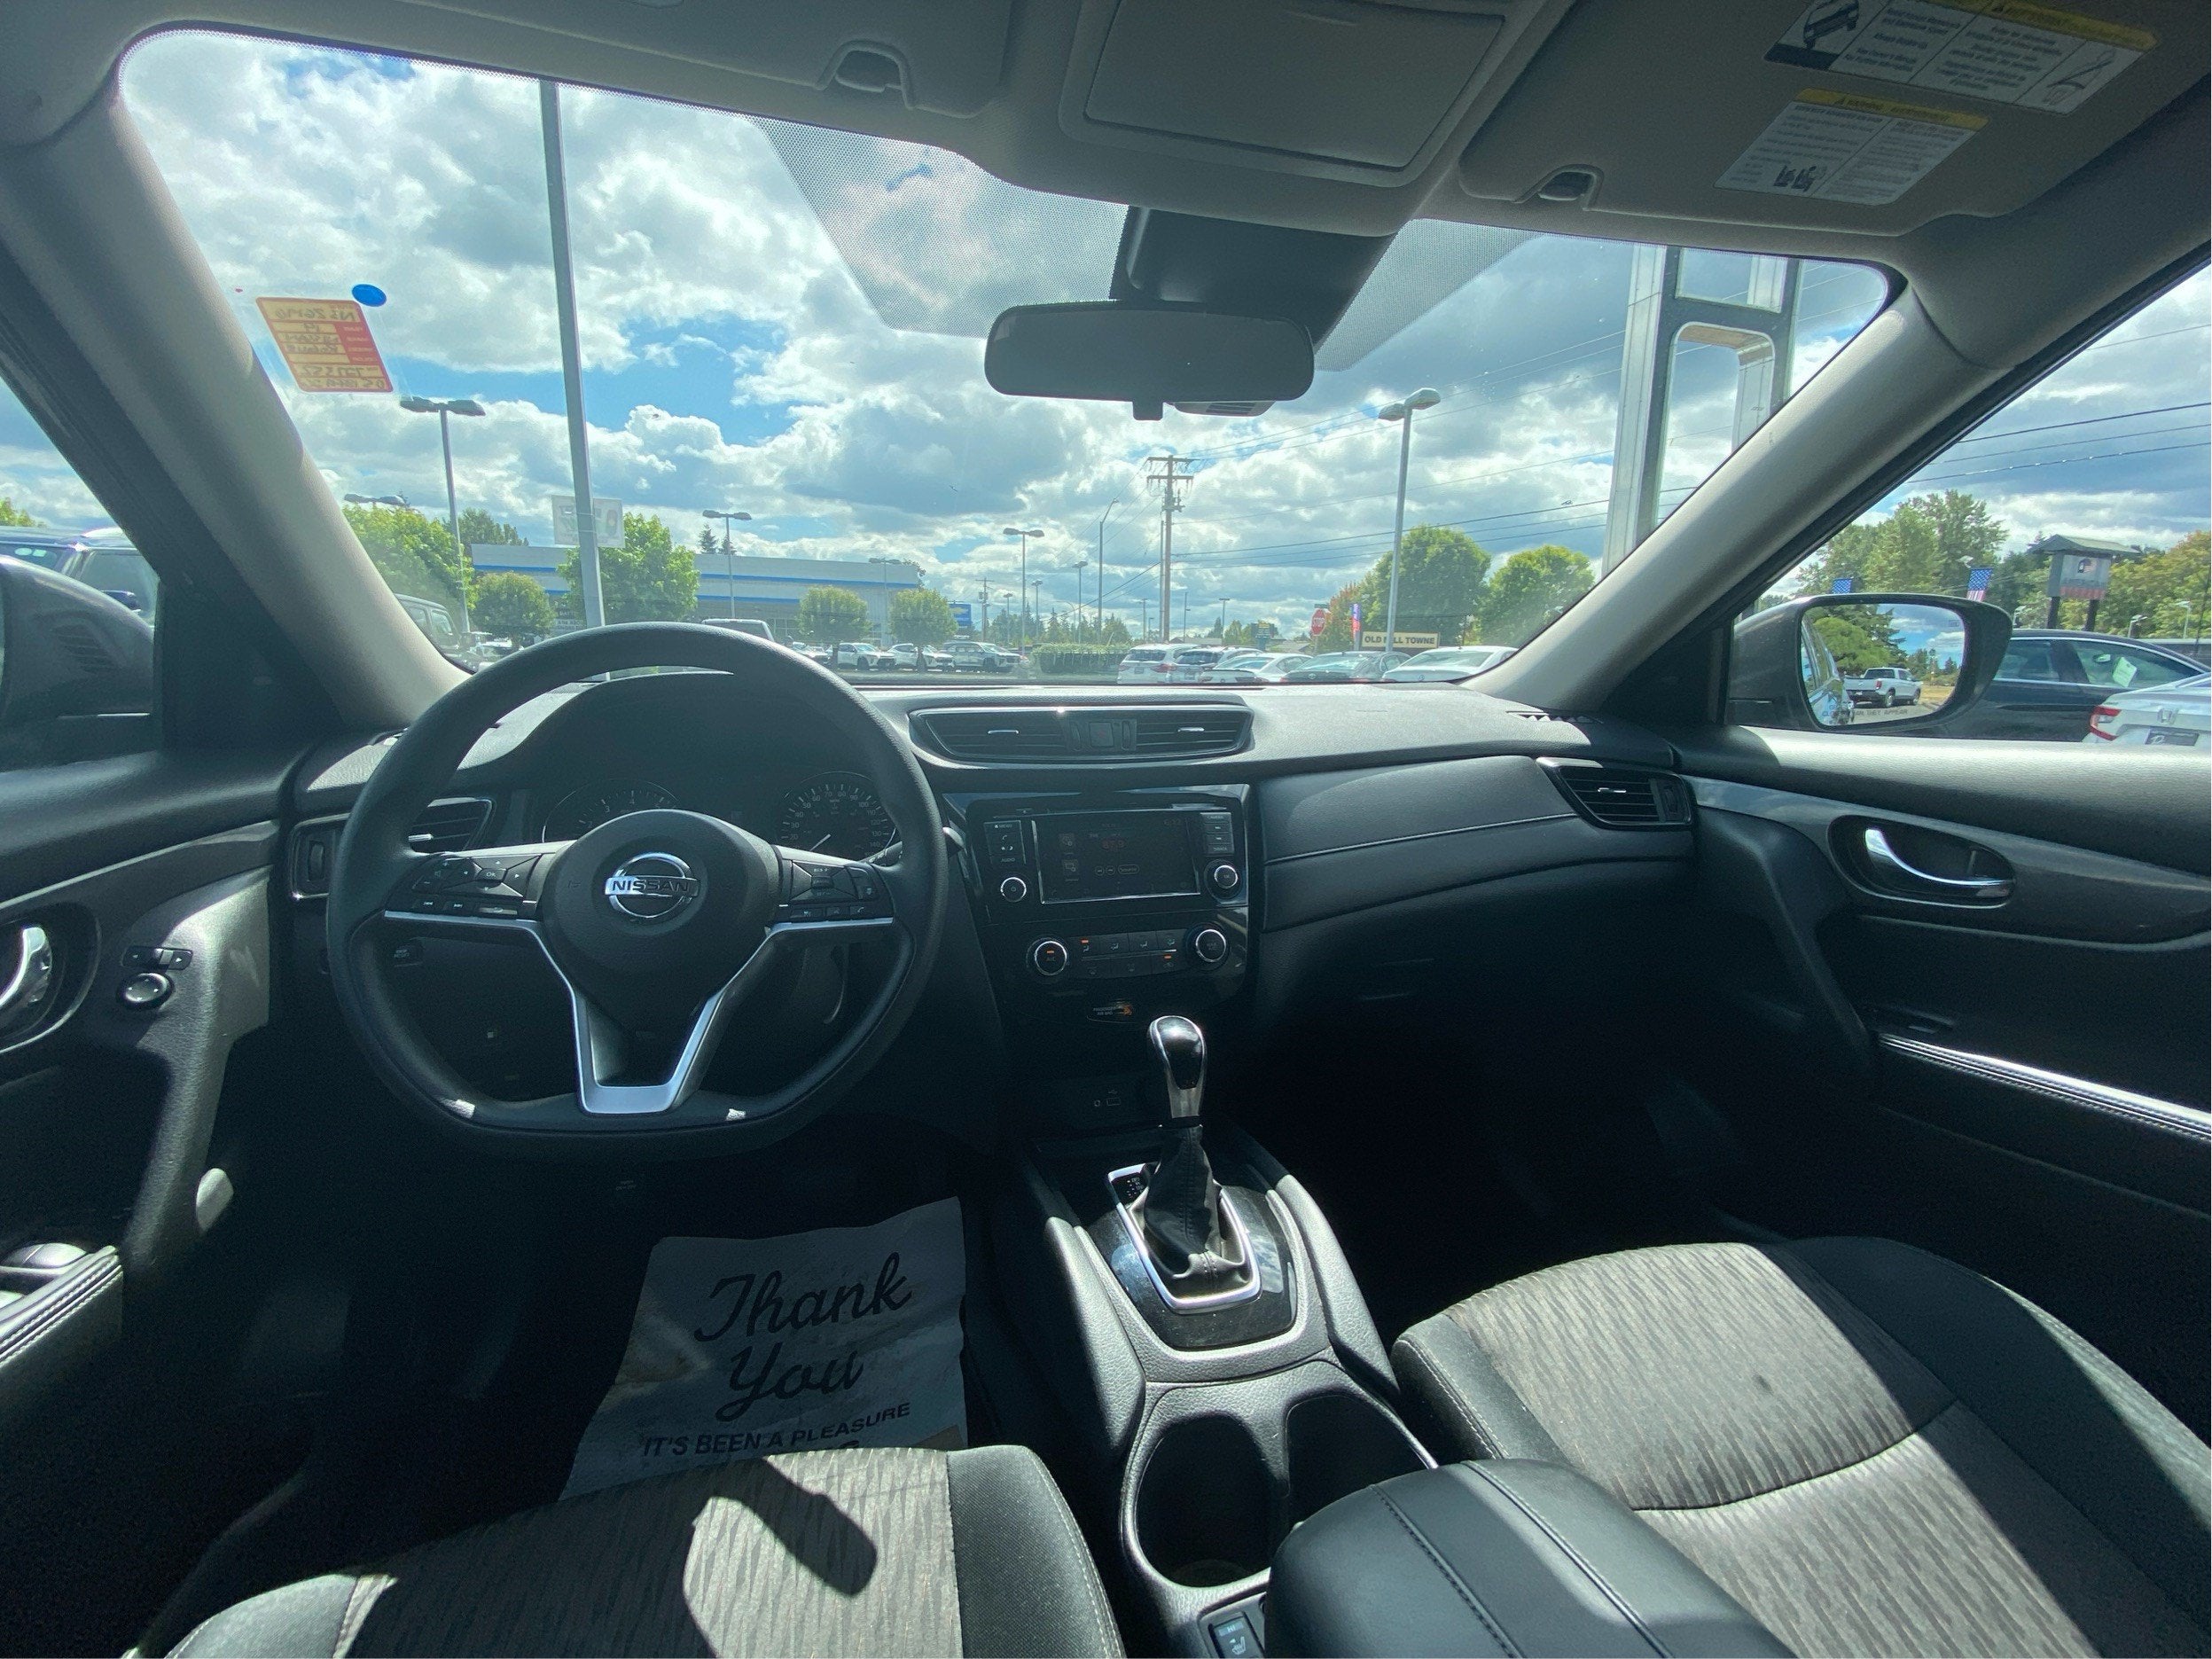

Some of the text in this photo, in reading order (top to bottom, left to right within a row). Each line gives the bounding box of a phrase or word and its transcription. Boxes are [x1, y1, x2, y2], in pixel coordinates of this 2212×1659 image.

[1364, 635, 1435, 646] OLD LL TOWNE
[612, 879, 689, 892] NISSAN
[695, 1251, 913, 1342] Thank
[715, 1342, 864, 1422] You
[643, 1402, 911, 1458] IT'S BEEN A PLEASURE
[1227, 1624, 1236, 1633] HI
